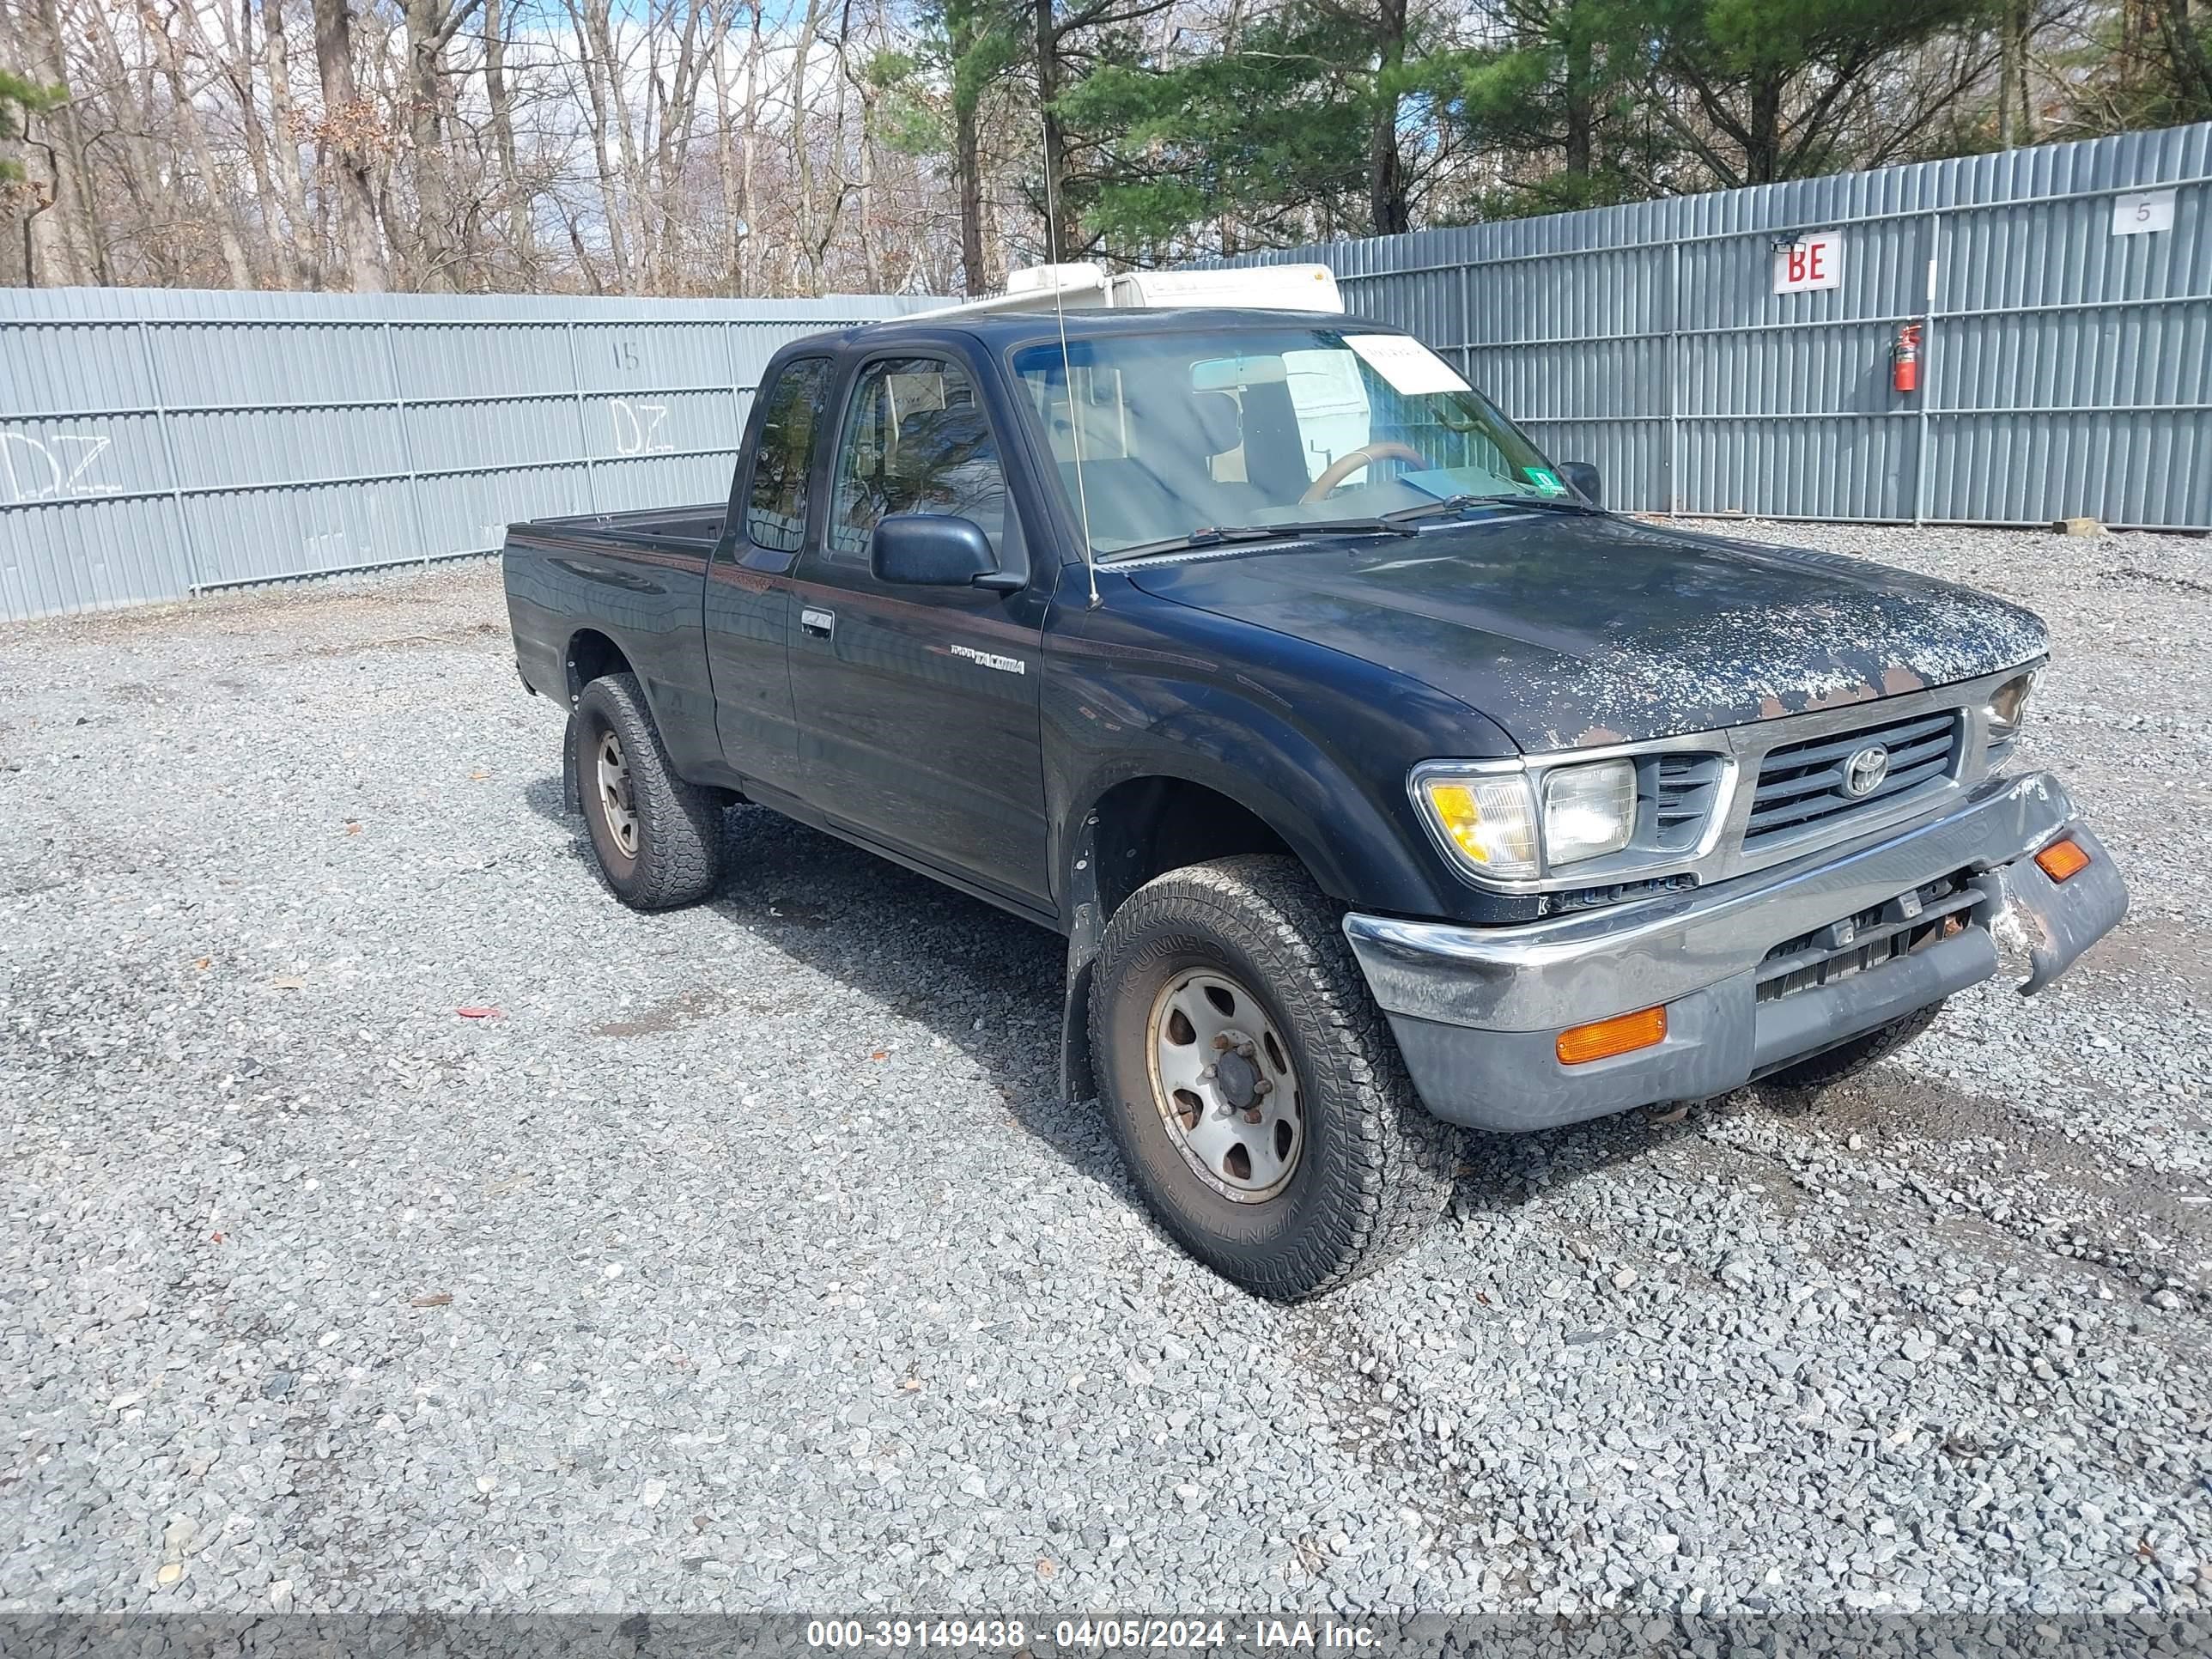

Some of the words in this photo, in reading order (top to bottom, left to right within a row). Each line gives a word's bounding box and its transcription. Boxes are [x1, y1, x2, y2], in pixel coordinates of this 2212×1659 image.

[2136, 202, 2151, 222] 5
[1789, 243, 1826, 283] BE
[612, 342, 639, 370] 15
[610, 399, 674, 455] DZ
[0, 432, 123, 502] DZ
[975, 651, 1024, 675] TACOMA
[1116, 933, 1230, 998] KUMHO
